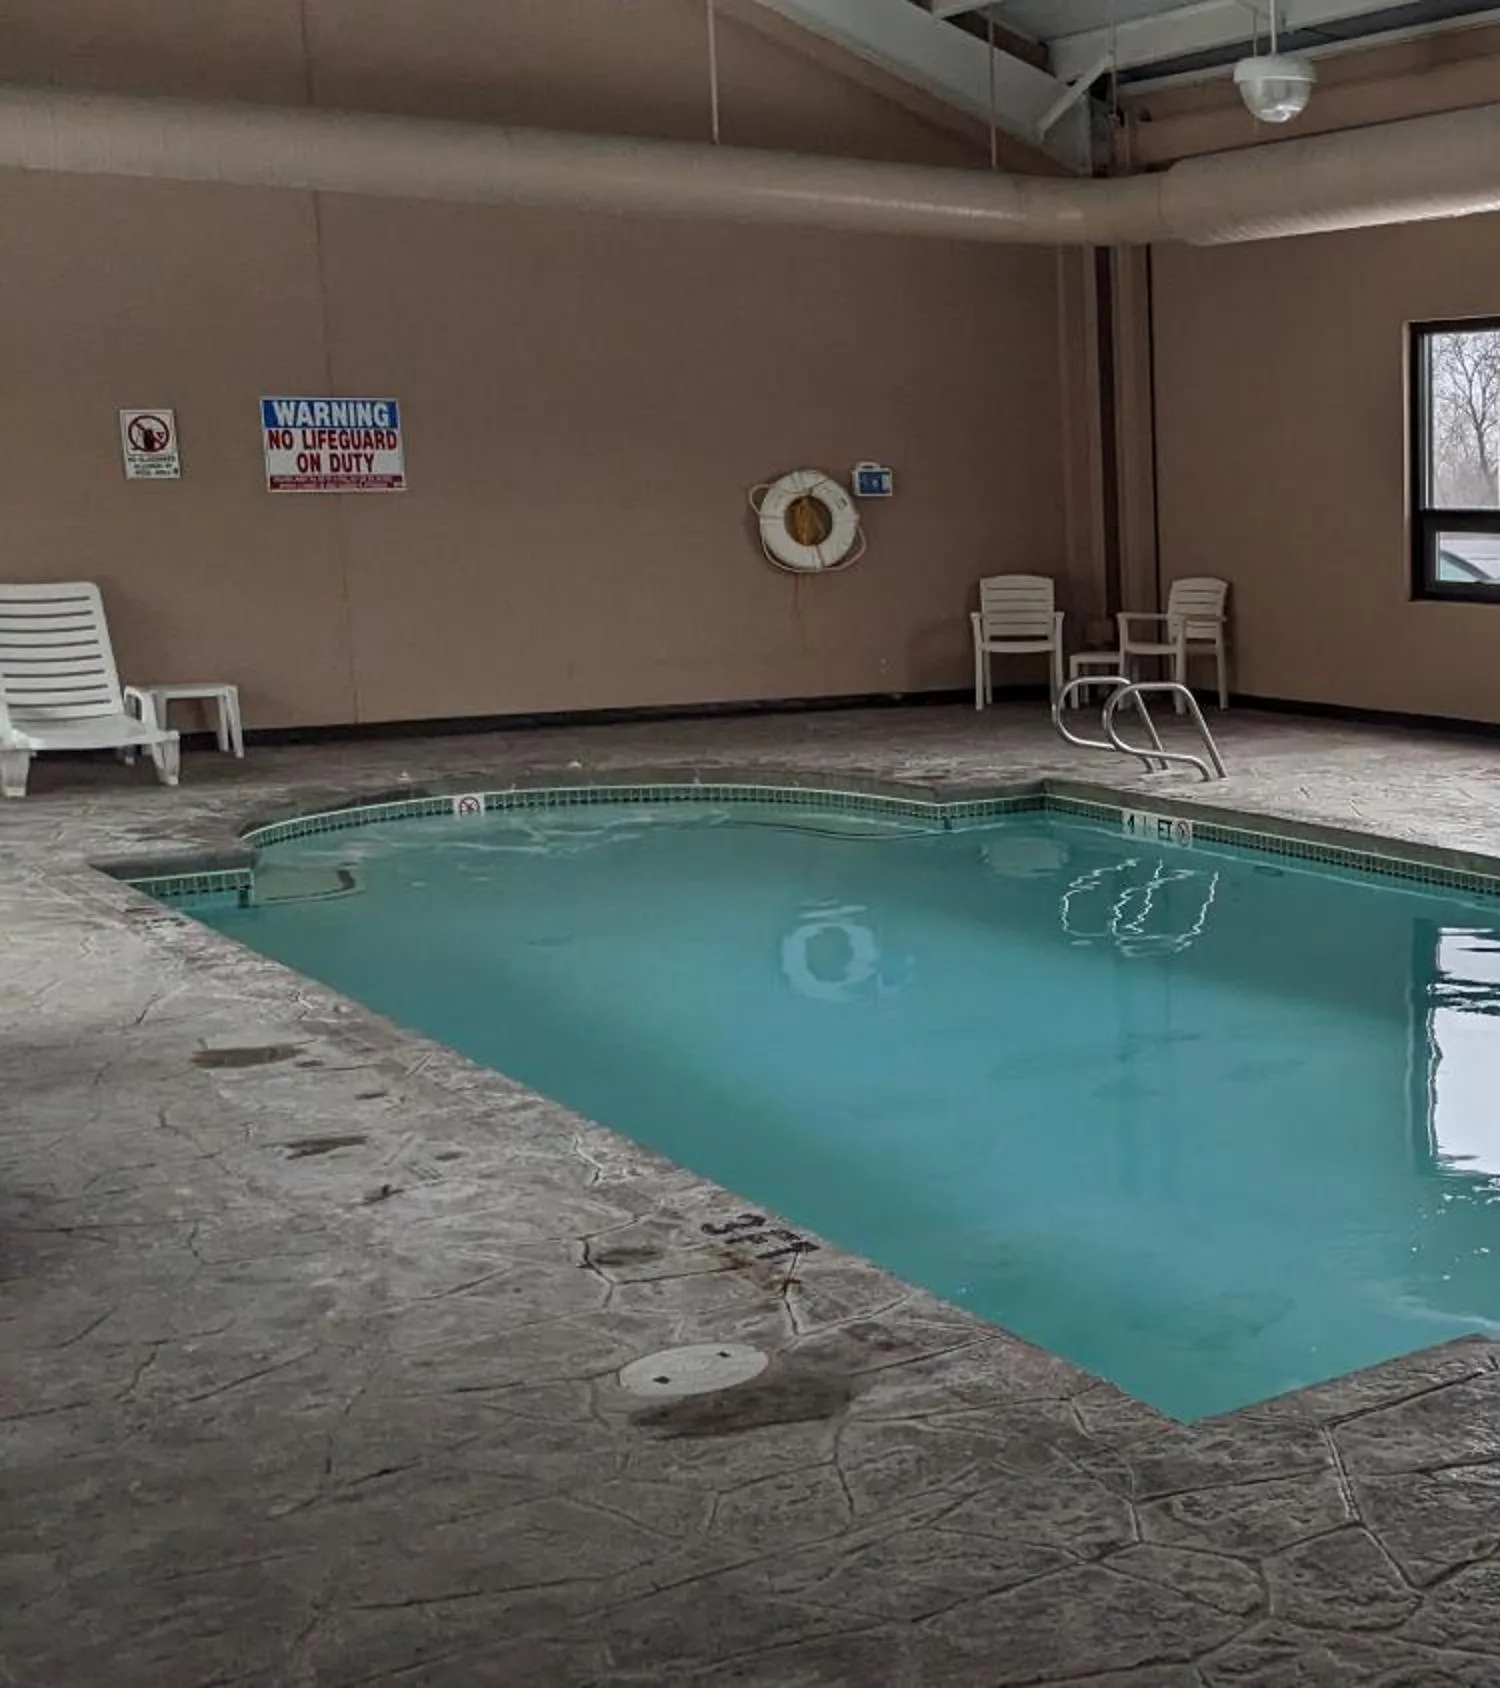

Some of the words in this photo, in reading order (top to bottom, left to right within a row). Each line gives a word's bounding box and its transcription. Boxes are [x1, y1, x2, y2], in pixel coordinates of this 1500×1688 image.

[272, 401, 390, 426] WARNING
[268, 429, 294, 450] NO
[302, 429, 397, 450] LIFEGUARD
[297, 452, 320, 473] ON
[329, 452, 374, 473] DUTY
